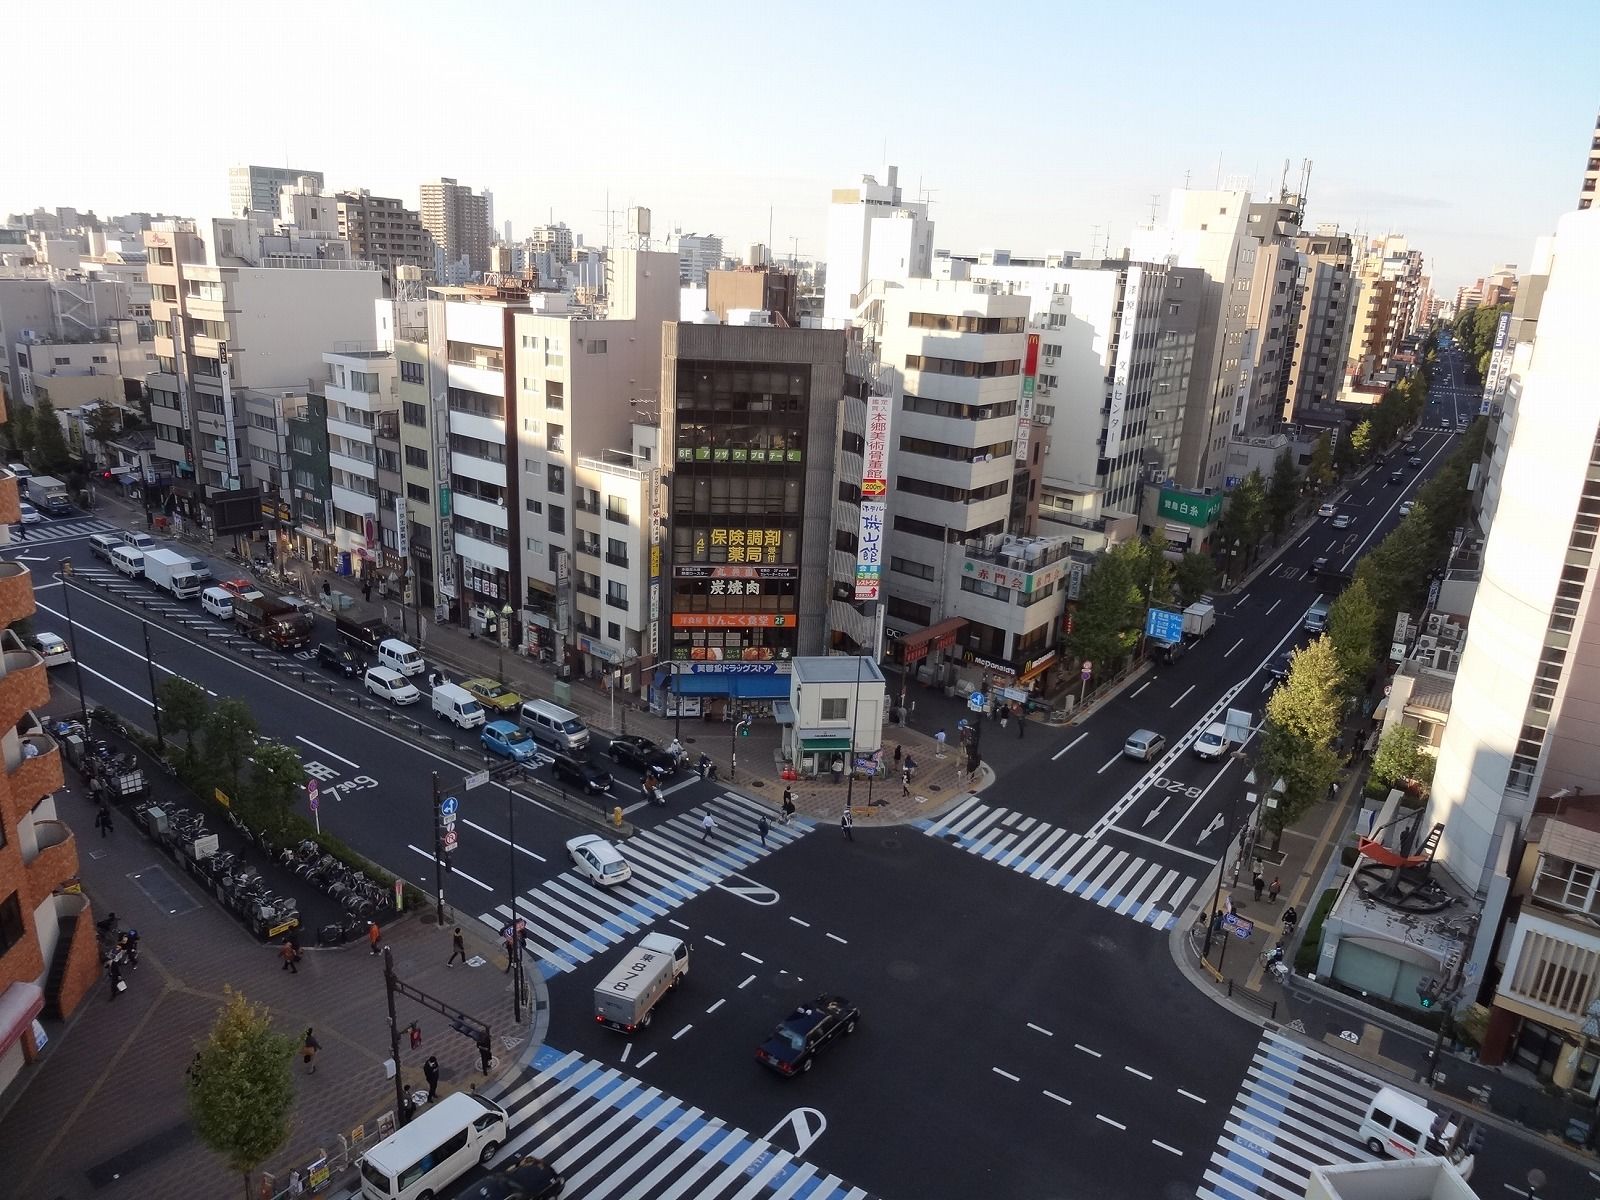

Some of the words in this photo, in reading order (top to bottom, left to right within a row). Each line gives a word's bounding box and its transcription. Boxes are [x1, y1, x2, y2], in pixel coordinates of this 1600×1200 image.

[867, 412, 887, 478] 本郷美術骨董館
[711, 529, 781, 546] 保険調剤
[860, 515, 882, 563] 機山館
[697, 538, 705, 554] 4F
[728, 546, 762, 562] 薬局
[978, 568, 1023, 589] 赤門会
[710, 580, 760, 595] 炭焼肉
[707, 615, 769, 625] せんごく食堂
[775, 617, 785, 625] 2F
[974, 657, 1016, 675] McDonald's
